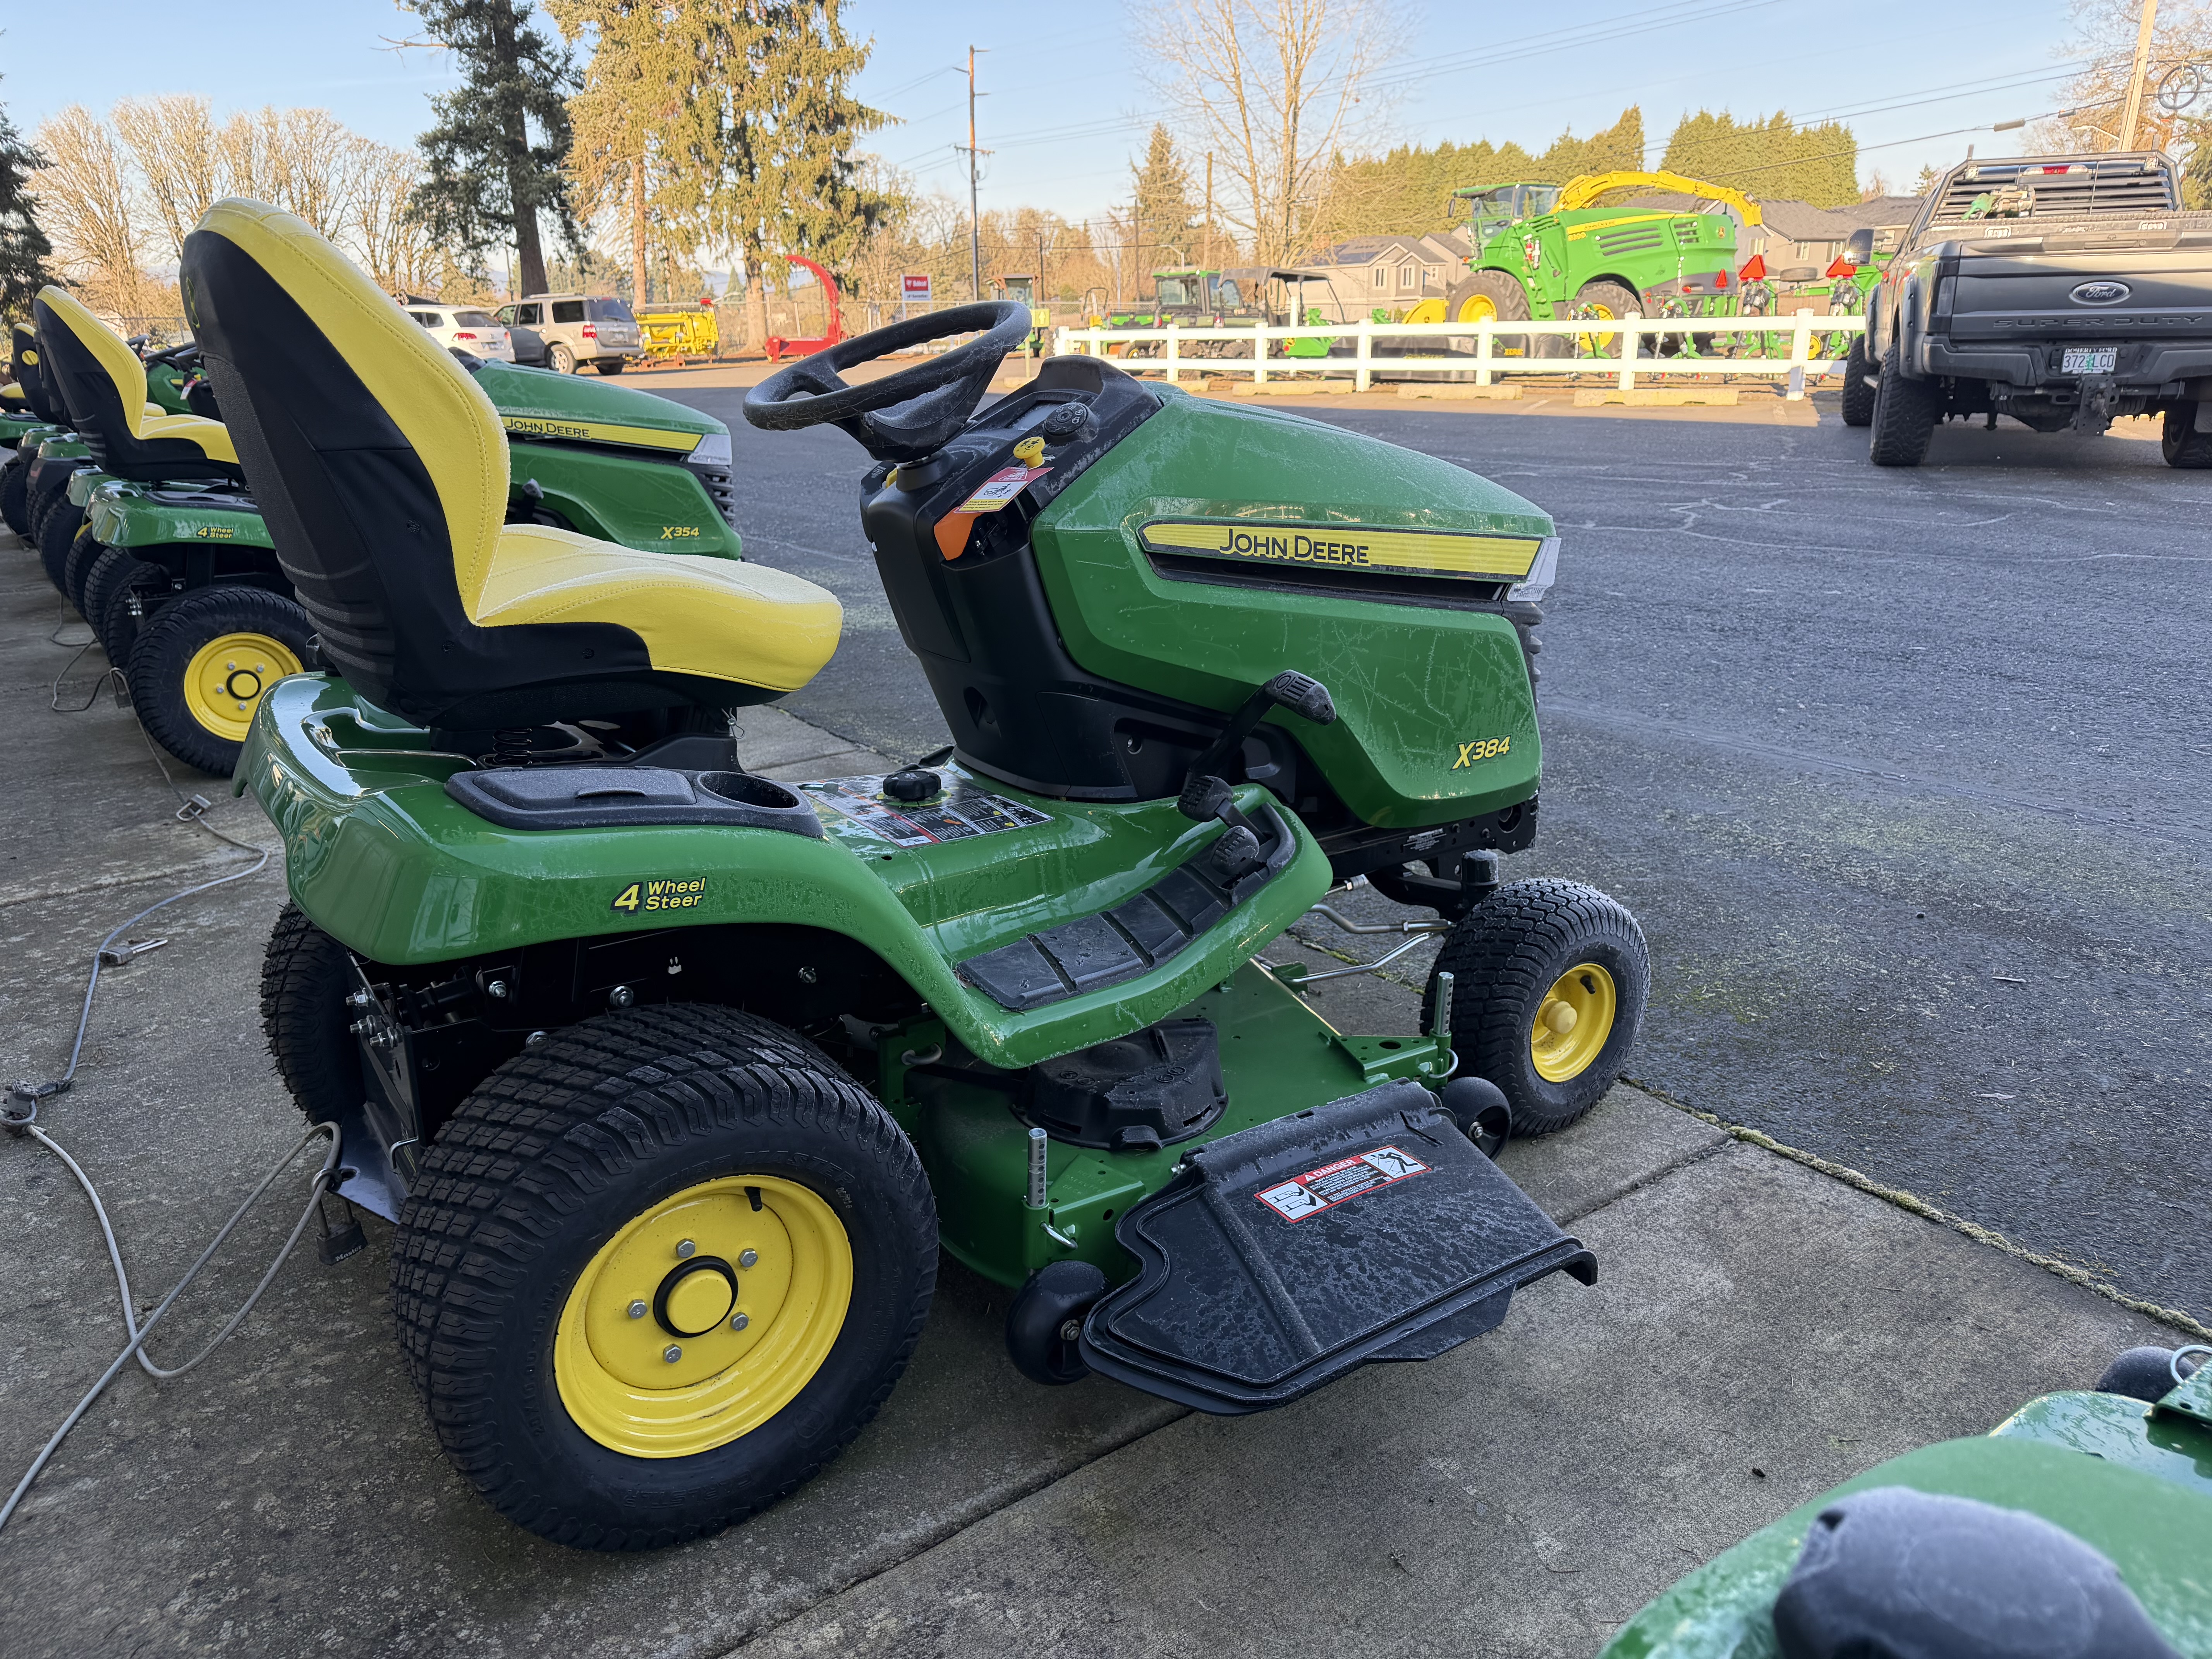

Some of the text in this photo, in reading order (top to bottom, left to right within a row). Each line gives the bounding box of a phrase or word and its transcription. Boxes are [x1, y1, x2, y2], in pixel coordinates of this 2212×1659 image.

[2086, 286, 2117, 298] Ford
[1993, 316, 2203, 328] SUPER DUTY
[2064, 354, 2114, 368] 372 LCD
[507, 419, 590, 437] JOHN DEERE
[198, 527, 208, 537] 4
[661, 527, 699, 539] X354
[1219, 529, 1369, 563] JOHN DEERE
[1452, 736, 1510, 769] X384
[614, 878, 706, 910] 4 Wheel
[646, 895, 702, 910] Steer
[740, 1150, 856, 1186] MASTER
[1313, 1159, 1355, 1177] DANGER
[335, 1245, 362, 1261] Master
